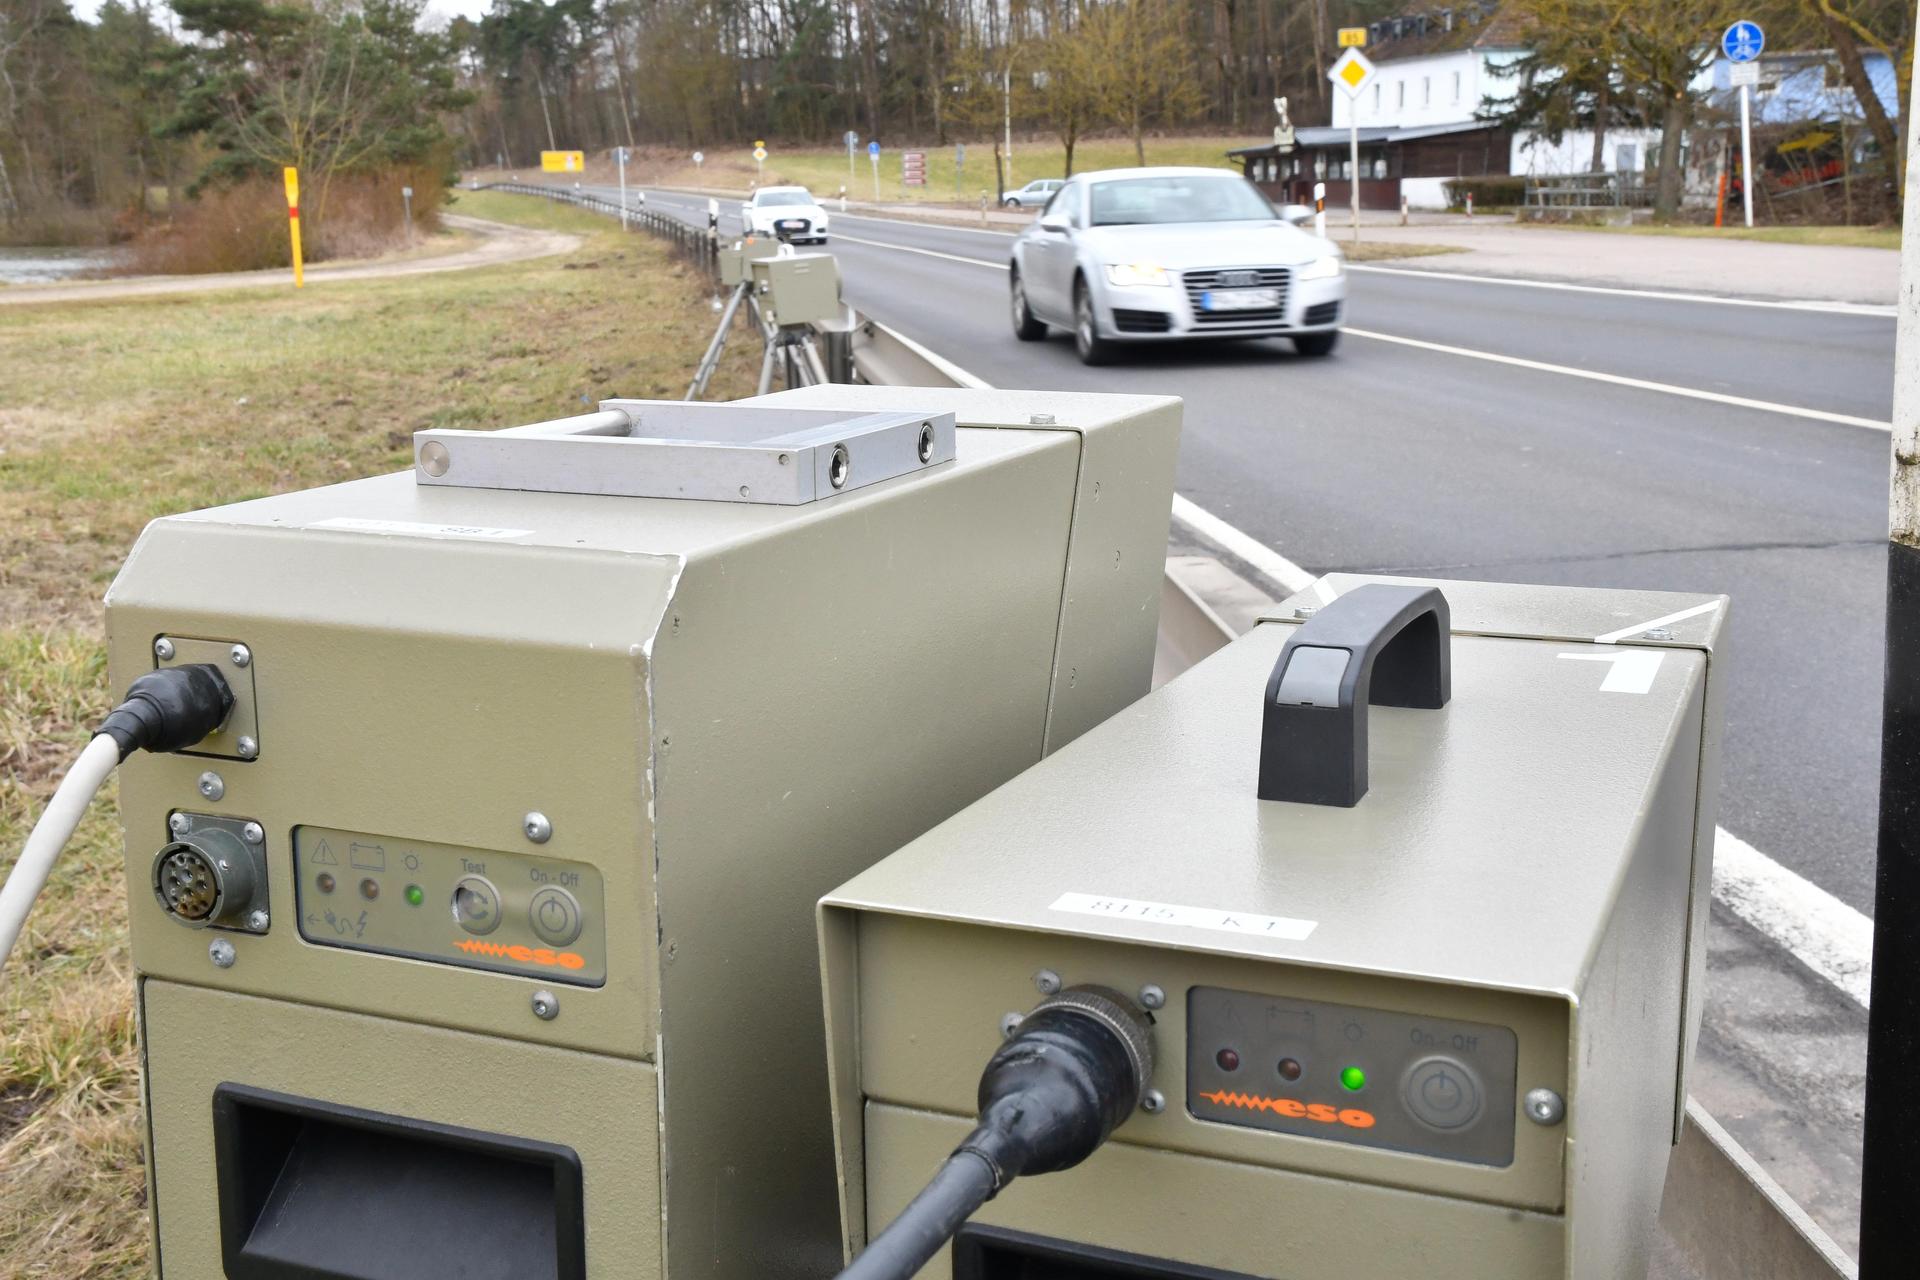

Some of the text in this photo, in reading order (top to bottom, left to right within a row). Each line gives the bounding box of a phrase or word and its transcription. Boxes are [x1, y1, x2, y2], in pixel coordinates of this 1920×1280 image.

[460, 858, 486, 874] Test
[530, 868, 548, 884] On
[559, 872, 579, 887] Off
[1410, 1028, 1435, 1047] On
[1452, 1034, 1479, 1051] Off
